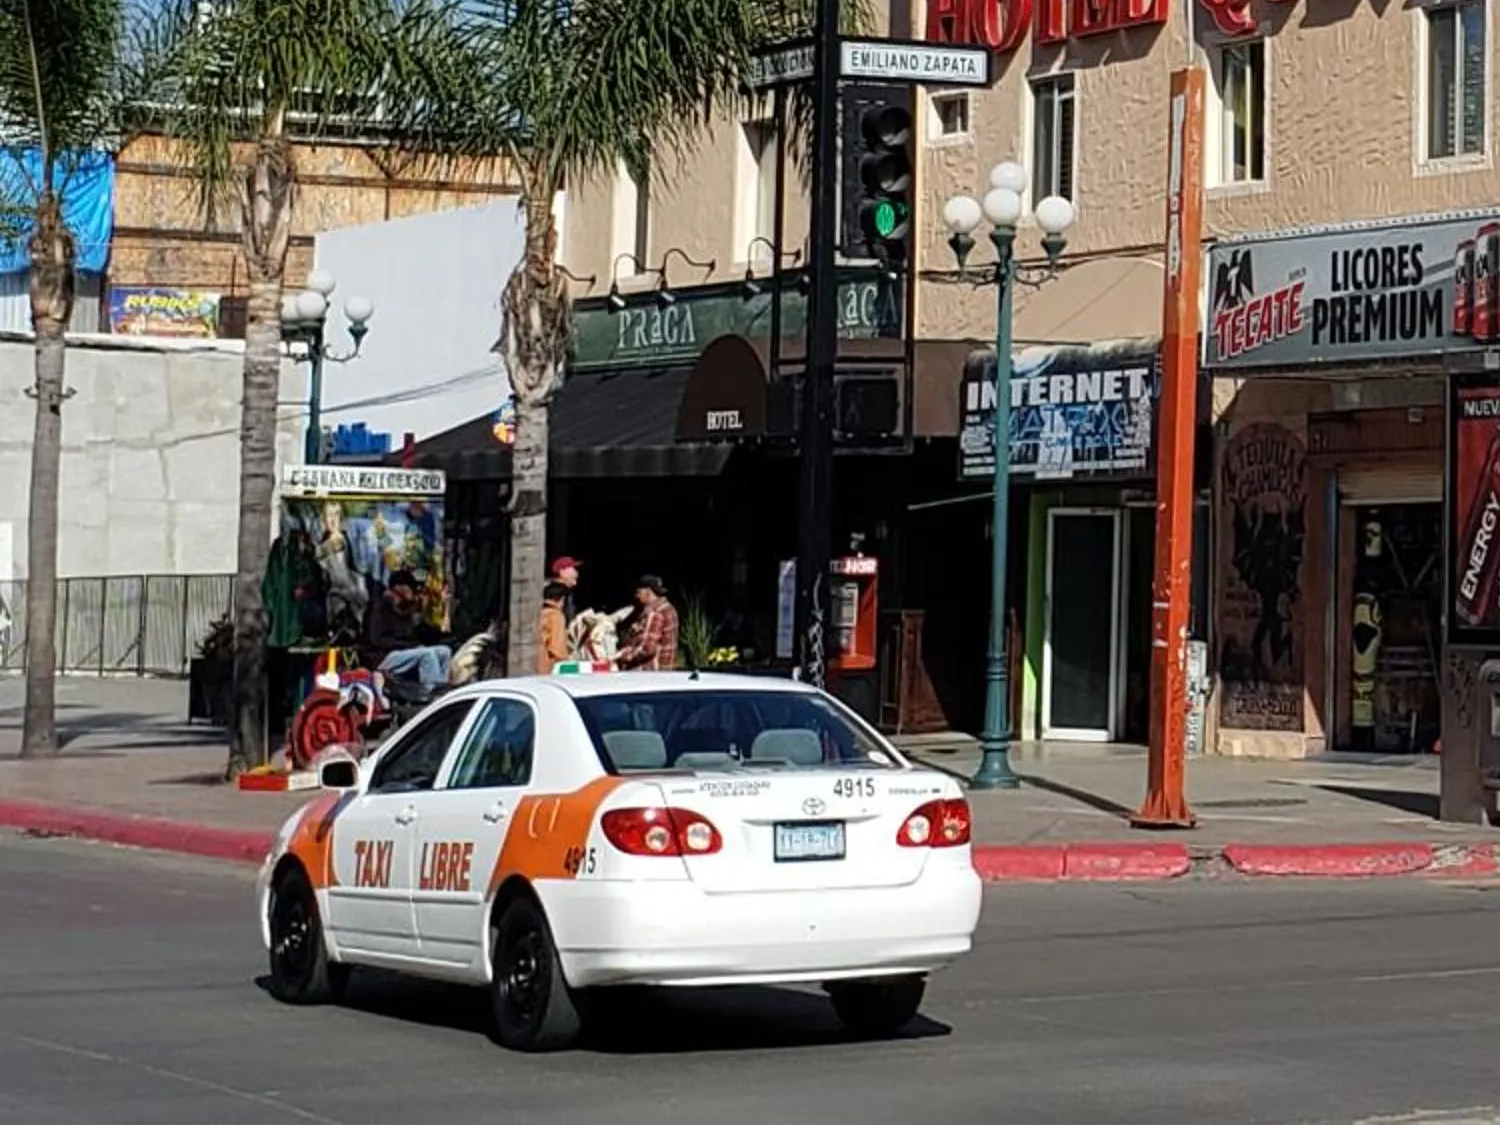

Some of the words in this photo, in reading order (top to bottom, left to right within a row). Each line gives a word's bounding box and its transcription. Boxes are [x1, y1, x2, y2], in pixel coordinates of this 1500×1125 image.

[851, 50, 919, 72] EMILIANO
[923, 55, 976, 74] ZAPATA
[1331, 243, 1424, 293] LICORES
[1214, 281, 1305, 362] TECATE
[1311, 289, 1444, 347] PREMIUM
[966, 367, 1149, 412] INTERNET
[706, 410, 742, 430] HOTEL
[1460, 490, 1500, 600] ENERGY
[833, 777, 875, 798] 4915
[354, 840, 395, 888] TAXI
[419, 841, 475, 892] LIBRE
[563, 846, 597, 875] 4915
